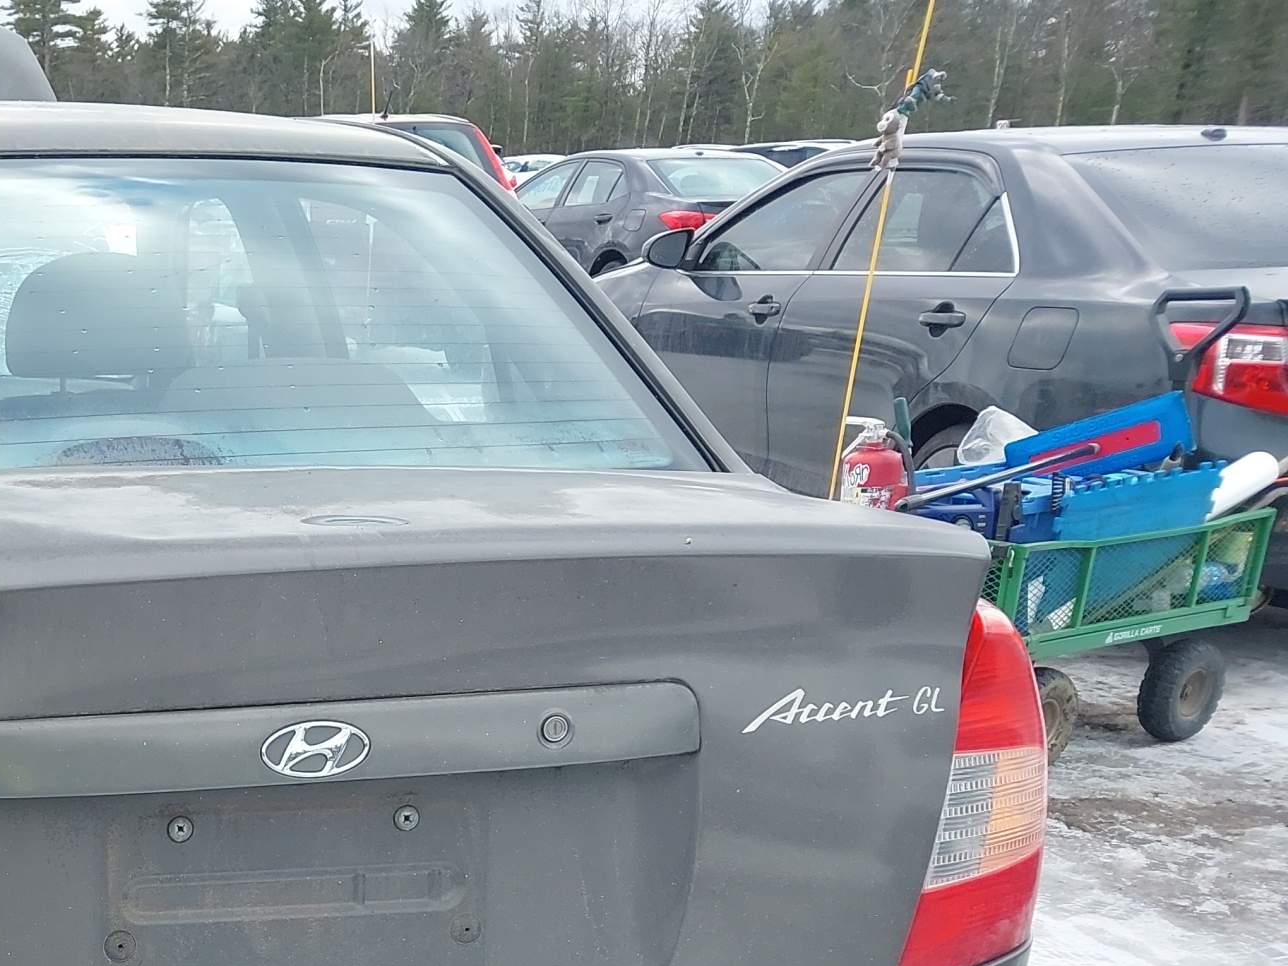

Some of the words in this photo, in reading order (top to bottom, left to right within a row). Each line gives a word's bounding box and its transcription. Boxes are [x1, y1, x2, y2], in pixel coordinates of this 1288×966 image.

[1113, 628, 1139, 641] GORILLA
[1140, 624, 1162, 636] CARTS
[741, 688, 910, 734] Accent
[913, 686, 945, 715] GL
